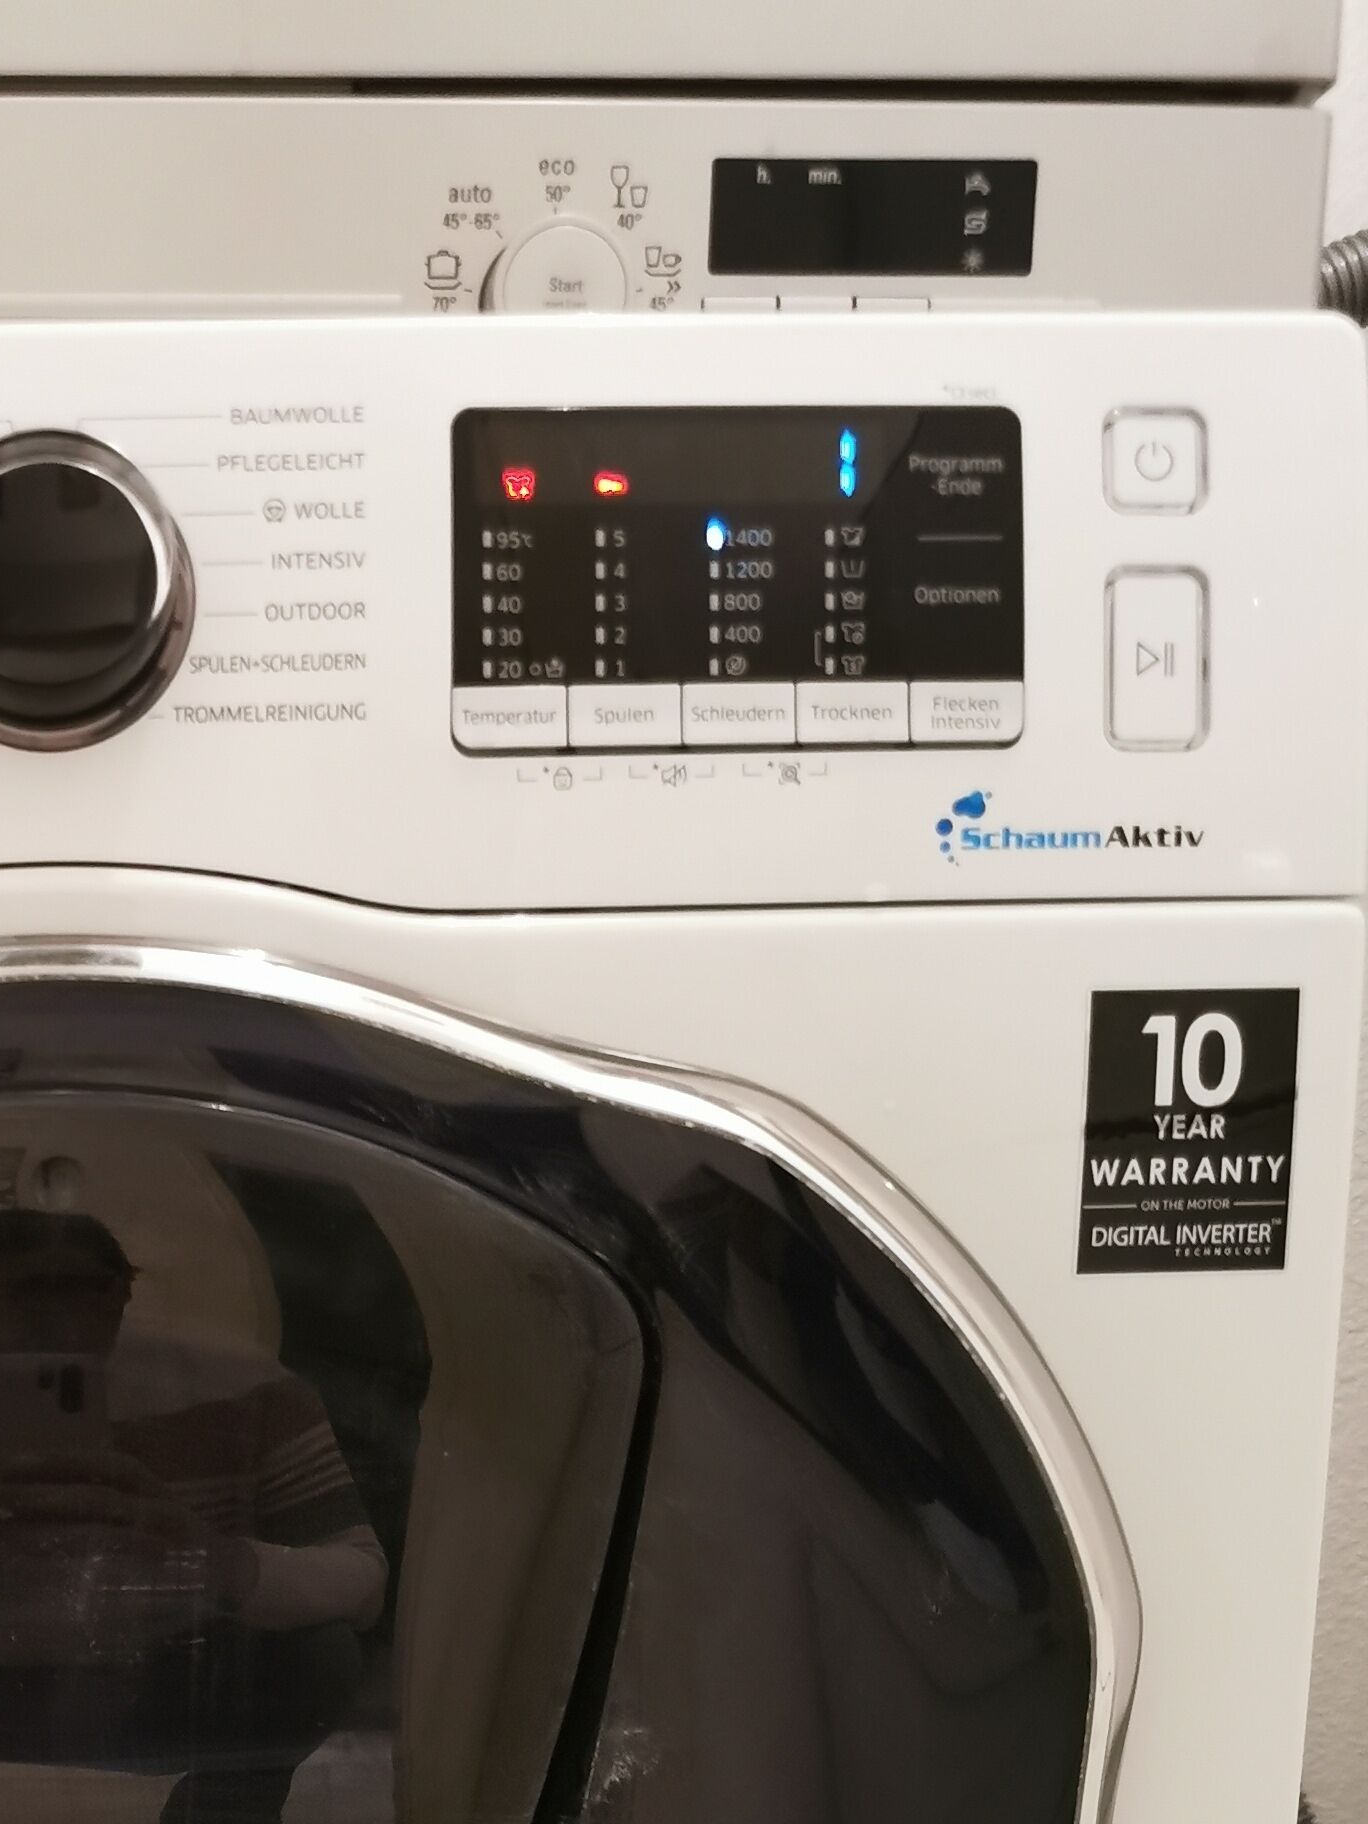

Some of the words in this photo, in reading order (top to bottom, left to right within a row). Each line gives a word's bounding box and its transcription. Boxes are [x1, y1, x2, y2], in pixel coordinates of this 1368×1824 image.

[538, 159, 576, 177] eco
[447, 184, 493, 203] auto
[548, 277, 583, 293] Start
[230, 406, 365, 425] BAUMWOLLE
[217, 452, 366, 472] PFLEGELEICHT
[908, 455, 1004, 476] Programm
[293, 501, 367, 521] WOLLE
[612, 530, 626, 548] 5
[725, 528, 774, 548] 1400
[271, 552, 367, 571] INTENSIV
[613, 562, 626, 580] 4
[725, 560, 774, 580] 1200
[496, 563, 522, 582] 60
[497, 595, 522, 614] 40
[615, 594, 627, 613] 3
[723, 593, 761, 612] 800
[914, 586, 1000, 606] Optionen
[264, 602, 367, 622] OUTDOOR
[498, 628, 523, 646] 30
[614, 627, 627, 645] 2
[724, 625, 762, 644] 400
[498, 660, 522, 679] 20
[616, 660, 625, 677] 1
[173, 702, 367, 724] TROMMELREINIGUNG
[691, 705, 785, 723] Schleudern
[811, 704, 893, 721] Trocknen
[932, 697, 1000, 713] Flecken
[461, 708, 557, 726] Temperatur
[931, 713, 1001, 731] Intensiv
[1140, 1012, 1244, 1108] 10
[1153, 1113, 1227, 1141] YEAR
[1089, 1154, 1285, 1187] WARRANTY
[1140, 1200, 1160, 1212] ON
[1163, 1200, 1184, 1211] THE
[1187, 1199, 1231, 1211] MOTOR
[1090, 1226, 1171, 1248] DIGITAL
[1174, 1246, 1272, 1258] TECHNOLOGY
